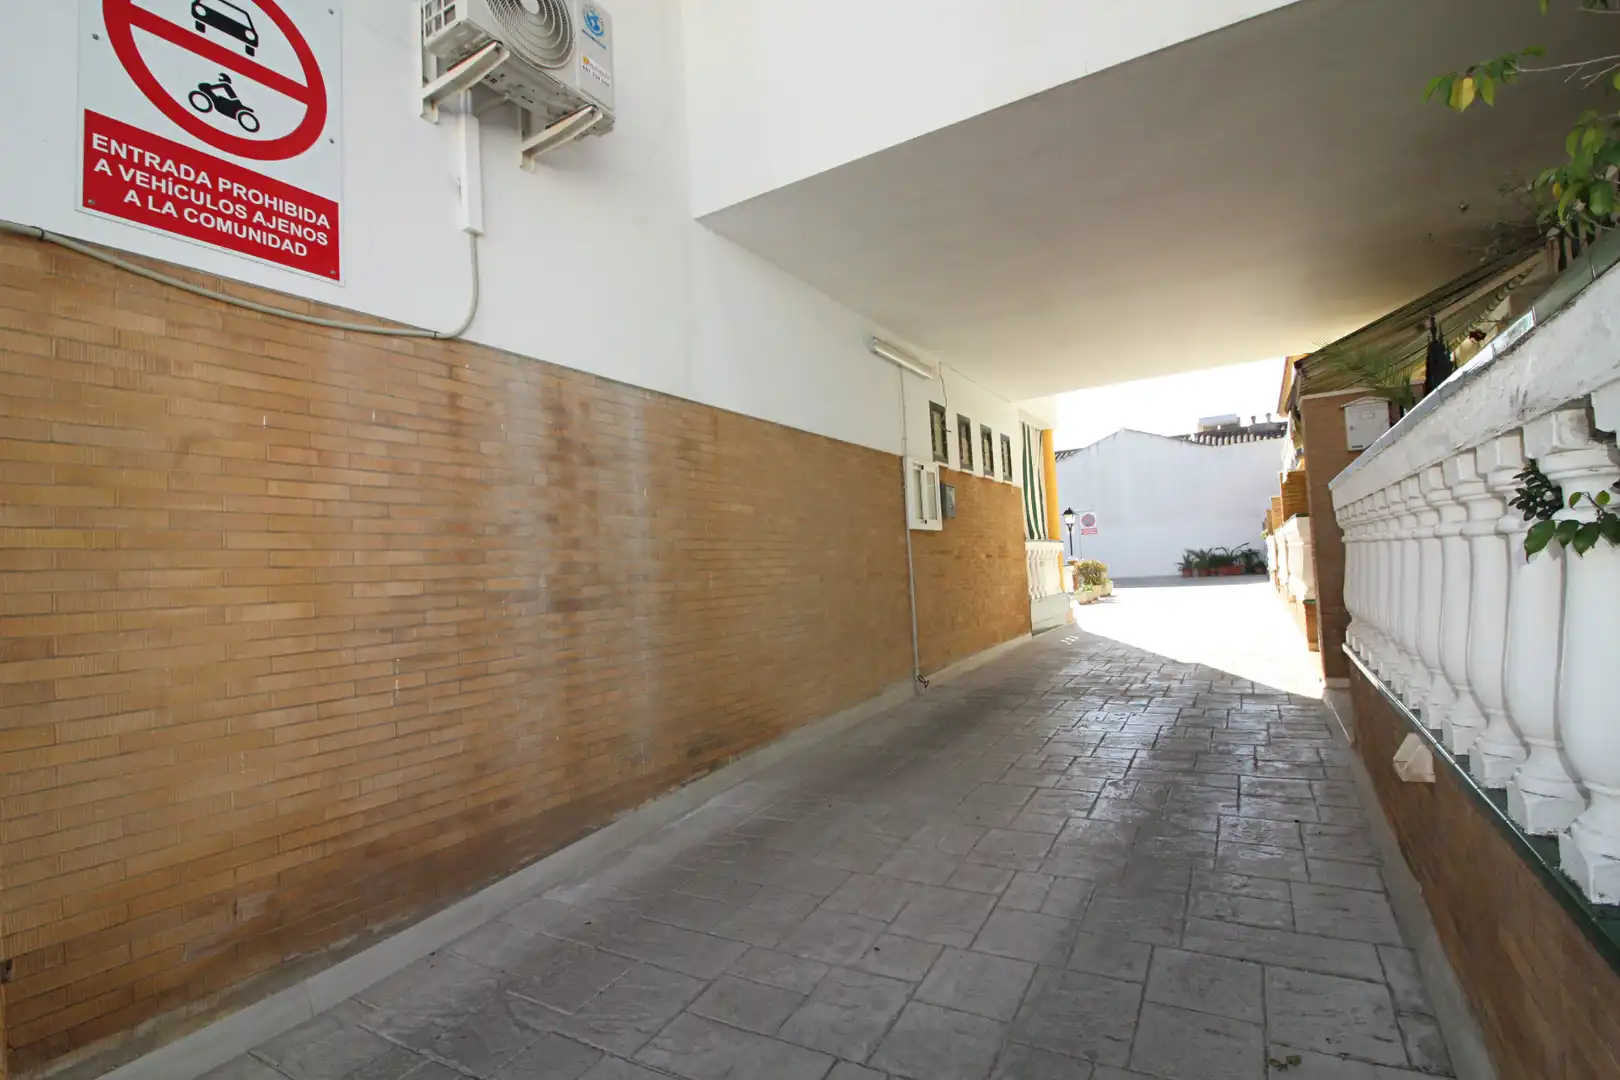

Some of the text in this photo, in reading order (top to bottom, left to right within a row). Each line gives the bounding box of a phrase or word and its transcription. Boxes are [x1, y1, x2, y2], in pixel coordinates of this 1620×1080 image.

[92, 132, 331, 230] ENTRADA PROHIBIDA
[94, 158, 328, 246] A VEHÍCULOS AJENOS
[123, 190, 308, 257] A LA COMUNIDAD
